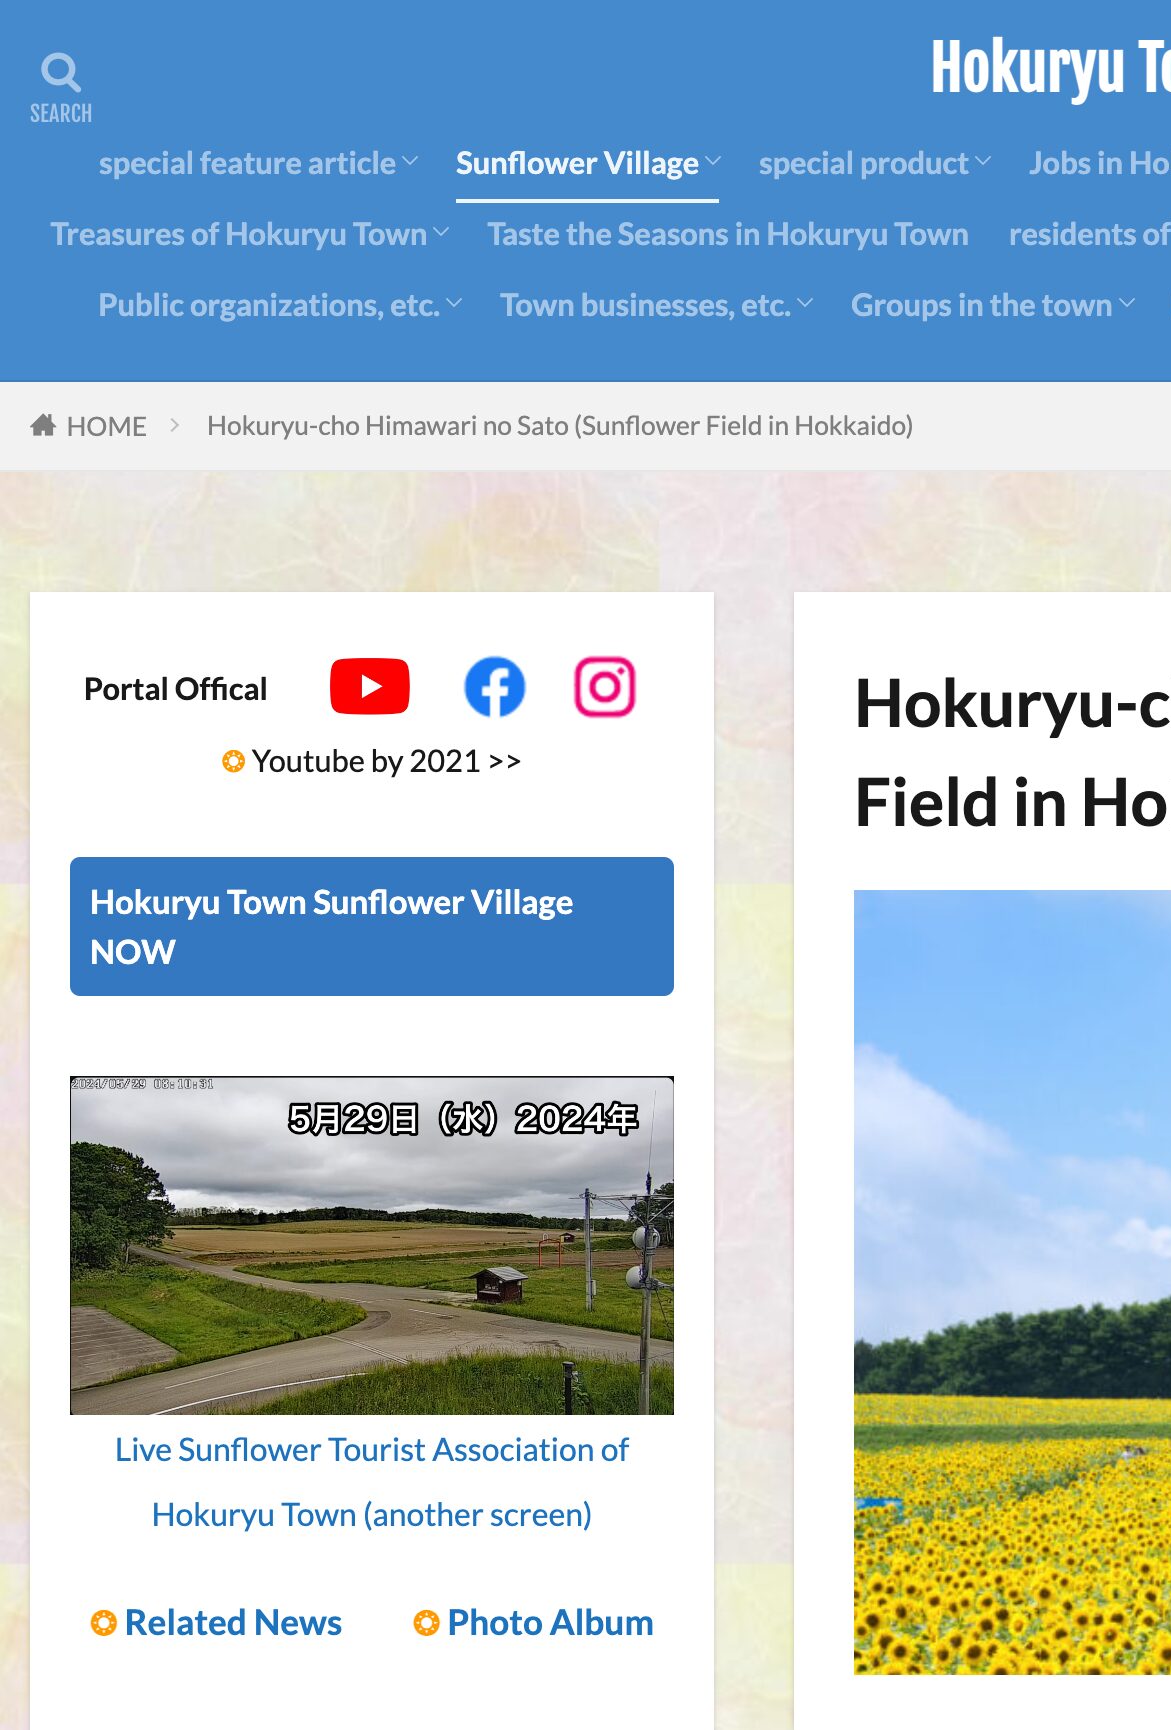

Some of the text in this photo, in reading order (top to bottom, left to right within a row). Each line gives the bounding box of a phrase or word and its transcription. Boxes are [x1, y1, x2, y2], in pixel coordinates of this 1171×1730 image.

[933, 35, 1124, 105] Hokuryu
[31, 103, 91, 122] SEARCH
[100, 150, 396, 180] special feature article
[456, 149, 699, 180] Sunflower Village
[760, 150, 969, 180] special product
[1029, 150, 1091, 175] Jobs
[1098, 151, 1122, 174] in
[50, 221, 426, 251] Treasures of Hokuryu Town
[487, 221, 968, 251] Taste the Seasons in Hokuryu Town
[1011, 221, 1136, 246] residents
[1143, 222, 1171, 246] of
[100, 292, 439, 322] Public organizations, etc.
[500, 292, 791, 320] Town businesses, etc.
[852, 292, 1112, 322] Groups in the town
[68, 416, 146, 436] HOME
[209, 413, 912, 440] Hokuryu-cho Himawari no Sato (Sunflower Field in Hokkaido)
[85, 675, 266, 703] Portal Offical
[251, 745, 366, 775] Youtube
[372, 748, 404, 778] by
[409, 745, 480, 773] 2021
[858, 776, 996, 827] Field
[1016, 776, 1065, 827] in
[91, 888, 576, 921] Hokuryu Town Sunflower Village
[91, 937, 176, 967] NOW
[117, 1437, 630, 1464] Live Sunflower Tourist Association of
[154, 1500, 591, 1532] Hokuryu Town (another screen)
[127, 1608, 342, 1639] Related News
[449, 1608, 654, 1636] Photo Album
